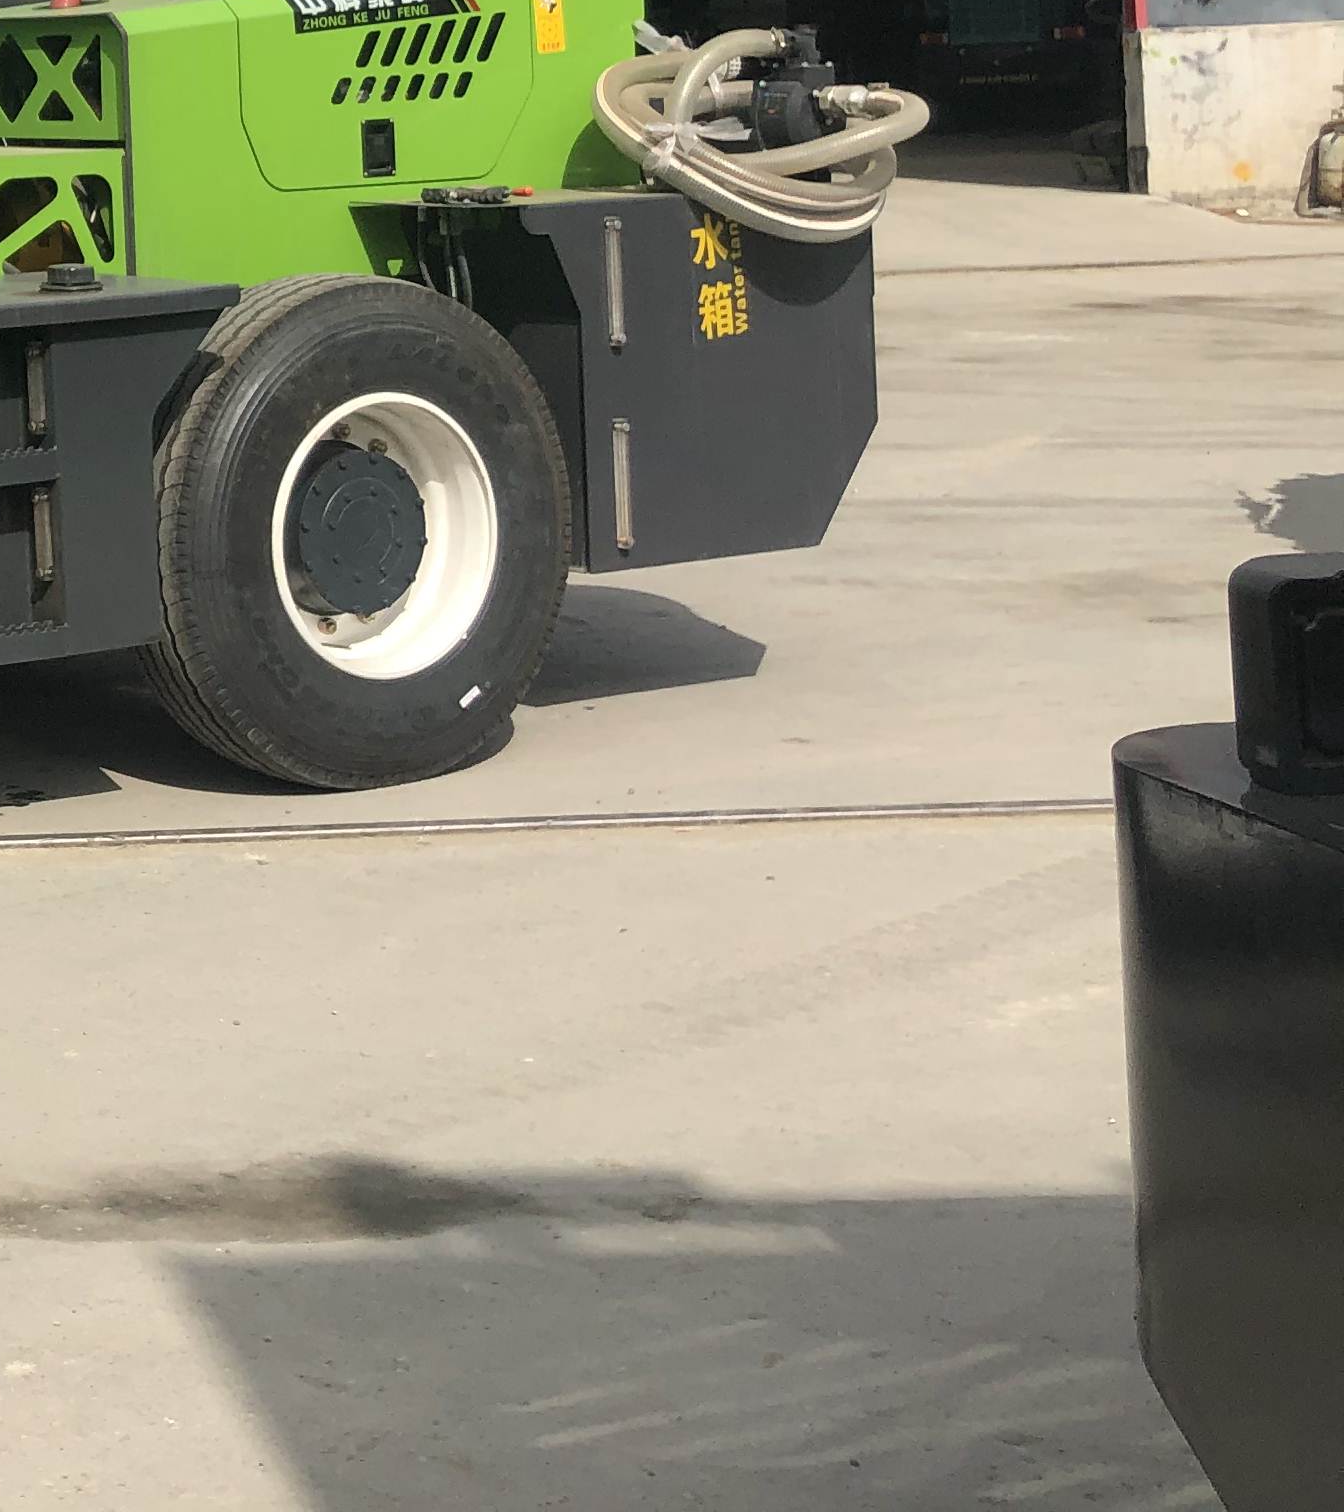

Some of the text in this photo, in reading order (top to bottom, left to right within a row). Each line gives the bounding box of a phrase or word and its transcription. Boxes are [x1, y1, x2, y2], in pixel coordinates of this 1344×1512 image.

[301, 3, 430, 31] ZHONG KE JU FENG
[690, 212, 734, 340] 水箱
[733, 264, 749, 335] Water
